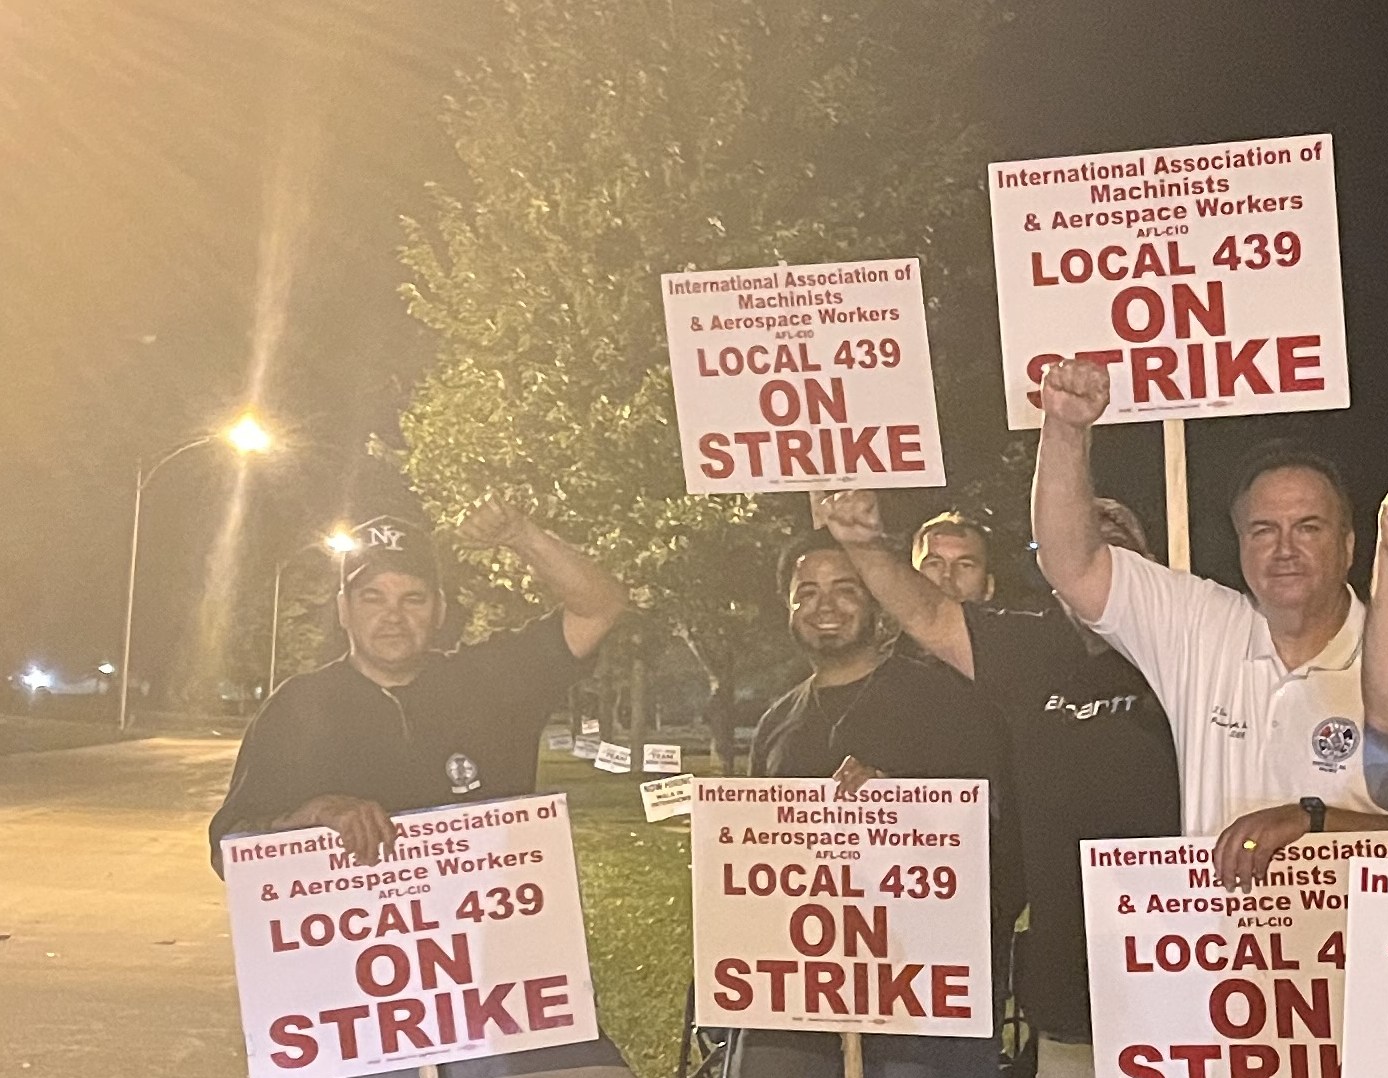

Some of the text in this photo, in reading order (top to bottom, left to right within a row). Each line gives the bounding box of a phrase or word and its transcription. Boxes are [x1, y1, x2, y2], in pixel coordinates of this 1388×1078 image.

[996, 140, 1323, 189] International Association of
[1090, 174, 1230, 205] Machinists
[1023, 194, 1304, 233] & Aerospace Workers
[1031, 230, 1302, 287] LOCAL 439
[668, 263, 912, 296] International Association of
[737, 289, 844, 310] Machinists
[690, 306, 900, 333] & Aerospace Workers
[1110, 279, 1227, 344] ON
[696, 337, 901, 378] LOCAL 439
[758, 376, 848, 427] ON
[698, 424, 927, 480] STRIKE
[698, 783, 827, 803] International
[833, 784, 952, 803] Association
[959, 783, 980, 804] of
[231, 830, 344, 862] Internati
[395, 808, 530, 838] Association
[777, 805, 898, 825] Machinists
[329, 836, 470, 870] Mhinists
[718, 826, 961, 851] & Aerospace Workers
[1090, 845, 1214, 867] Internatio
[260, 849, 544, 902] & Aerospace Workers
[723, 862, 958, 901] LOCAL 439
[1188, 864, 1338, 889] Mainists
[269, 882, 545, 953] LOCAL 439
[1117, 894, 1137, 915] &
[1146, 893, 1292, 918] Aerospace
[1237, 915, 1293, 929] AFL-CIO
[788, 902, 889, 959] ON
[354, 932, 474, 998] ON
[1124, 931, 1301, 973] LOCAL
[713, 957, 972, 1019] STRIKE
[1208, 977, 1333, 1040] ON
[268, 974, 575, 1070] STRIKE
